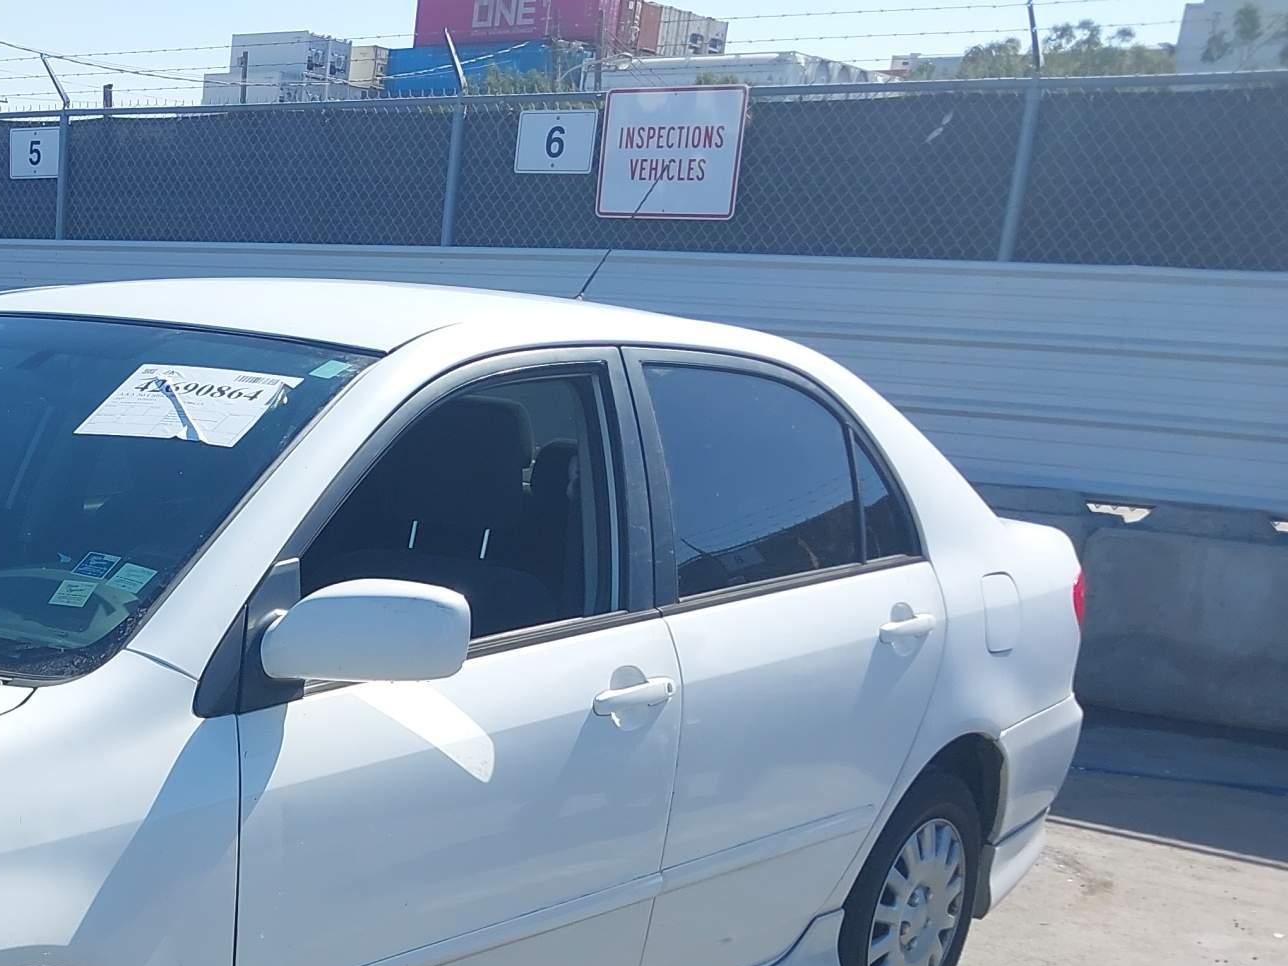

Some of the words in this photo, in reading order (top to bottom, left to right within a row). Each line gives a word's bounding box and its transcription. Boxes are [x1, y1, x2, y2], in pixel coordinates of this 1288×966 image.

[472, 0, 536, 28] ONE
[545, 126, 566, 158] 6
[619, 125, 725, 150] INSPECTIONS
[28, 140, 42, 166] 5
[629, 158, 706, 182] VEHICLES
